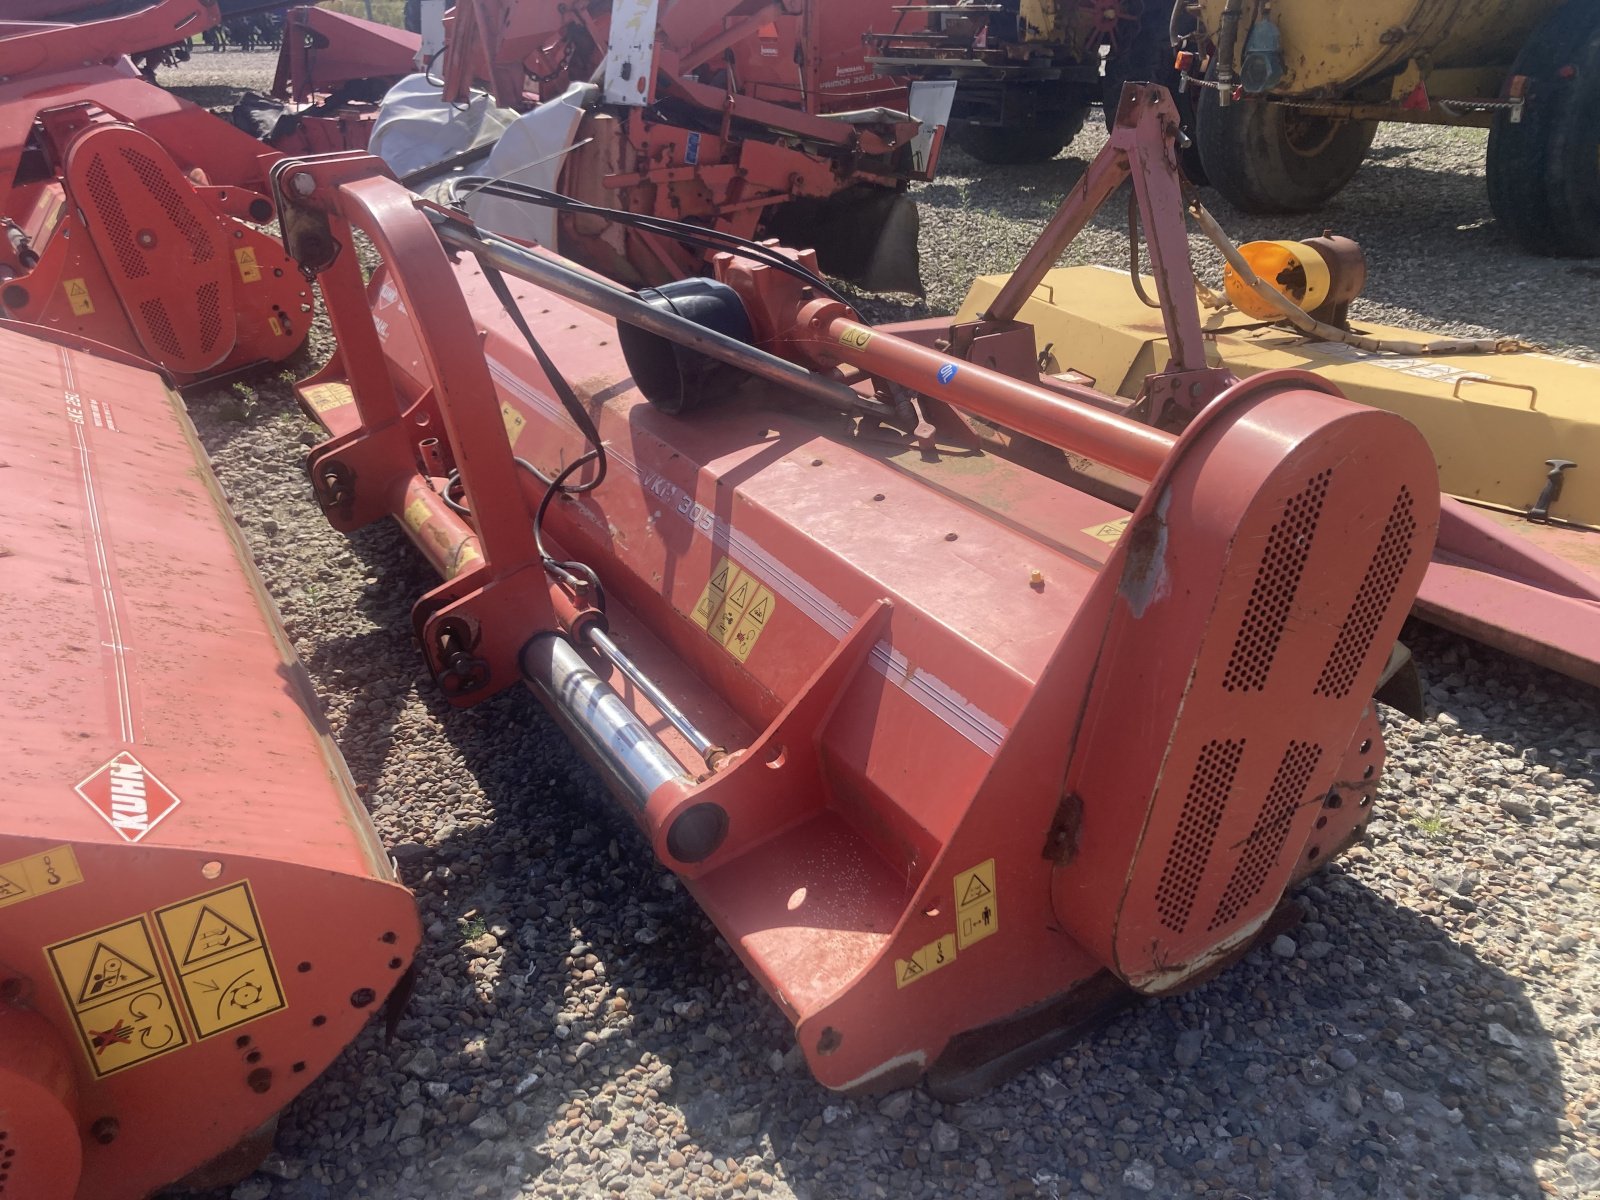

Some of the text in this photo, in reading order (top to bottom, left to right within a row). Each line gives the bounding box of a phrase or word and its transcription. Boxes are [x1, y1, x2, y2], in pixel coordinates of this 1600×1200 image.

[940, 364, 953, 384] OIL
[677, 495, 715, 530] 305
[110, 762, 148, 831] KUHN
